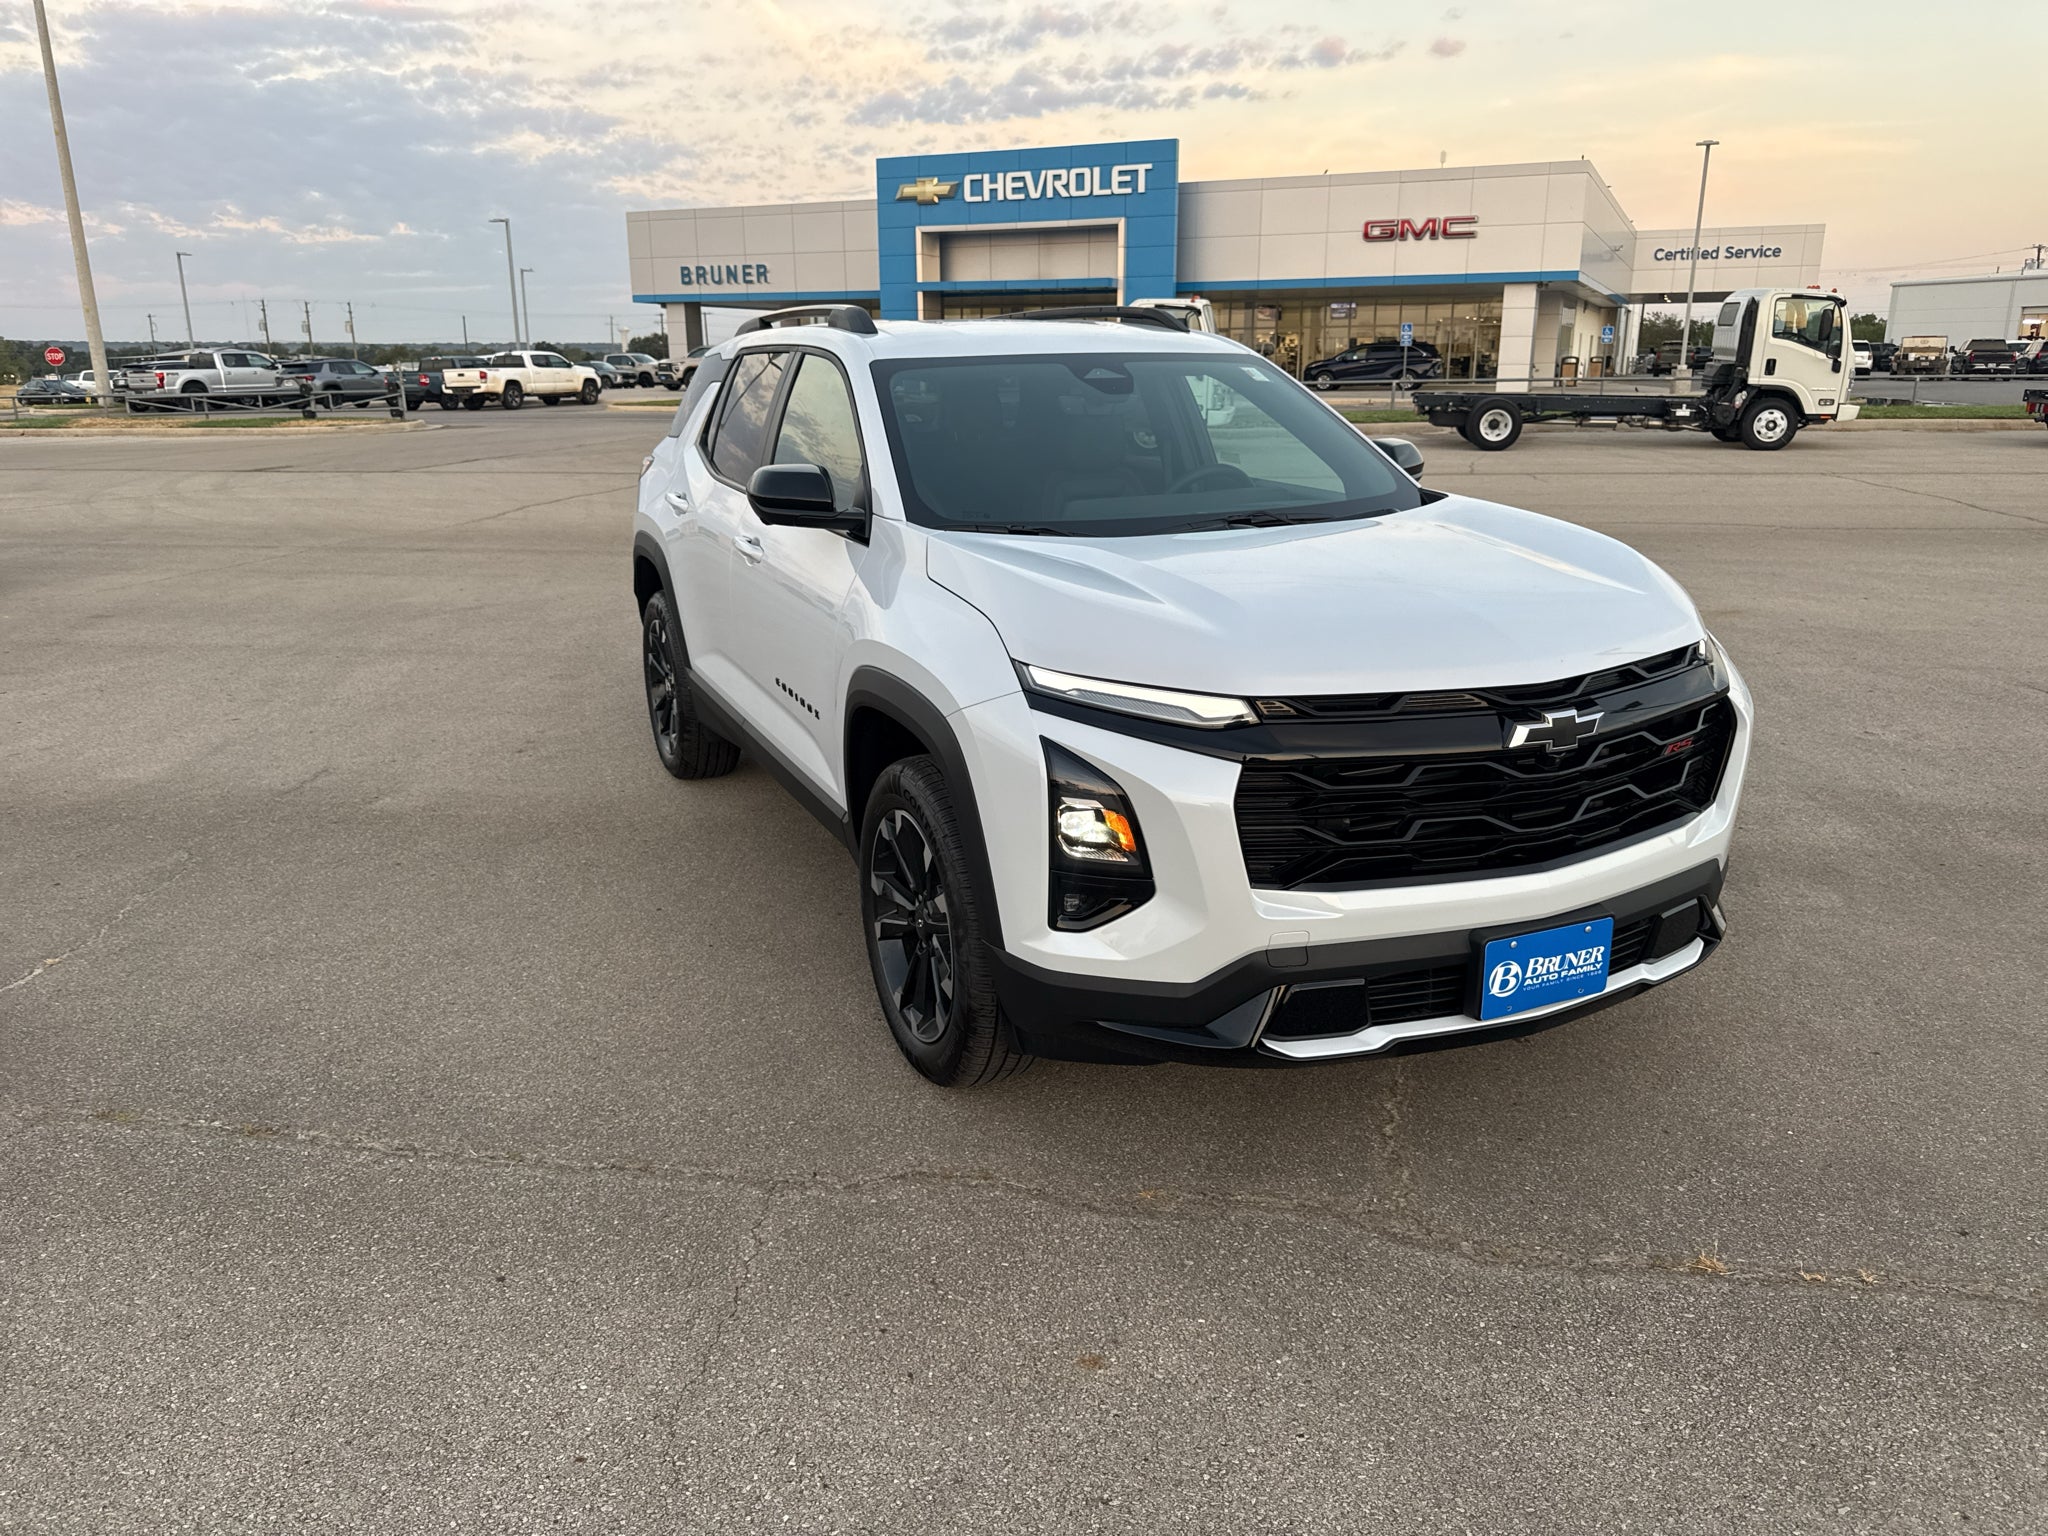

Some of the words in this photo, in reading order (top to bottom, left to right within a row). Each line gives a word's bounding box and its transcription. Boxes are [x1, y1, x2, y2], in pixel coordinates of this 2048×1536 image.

[963, 164, 1152, 203] CHEVROLET
[1363, 215, 1479, 242] GMC
[1724, 245, 1782, 259] Service
[680, 264, 770, 286] BRUNER
[46, 352, 63, 361] STOP
[1665, 738, 1693, 754] RS
[1524, 945, 1605, 978] BRUNER
[1523, 972, 1558, 986] AUTO
[1561, 962, 1603, 978] FAMILY
[1542, 979, 1564, 987] FAMILY
